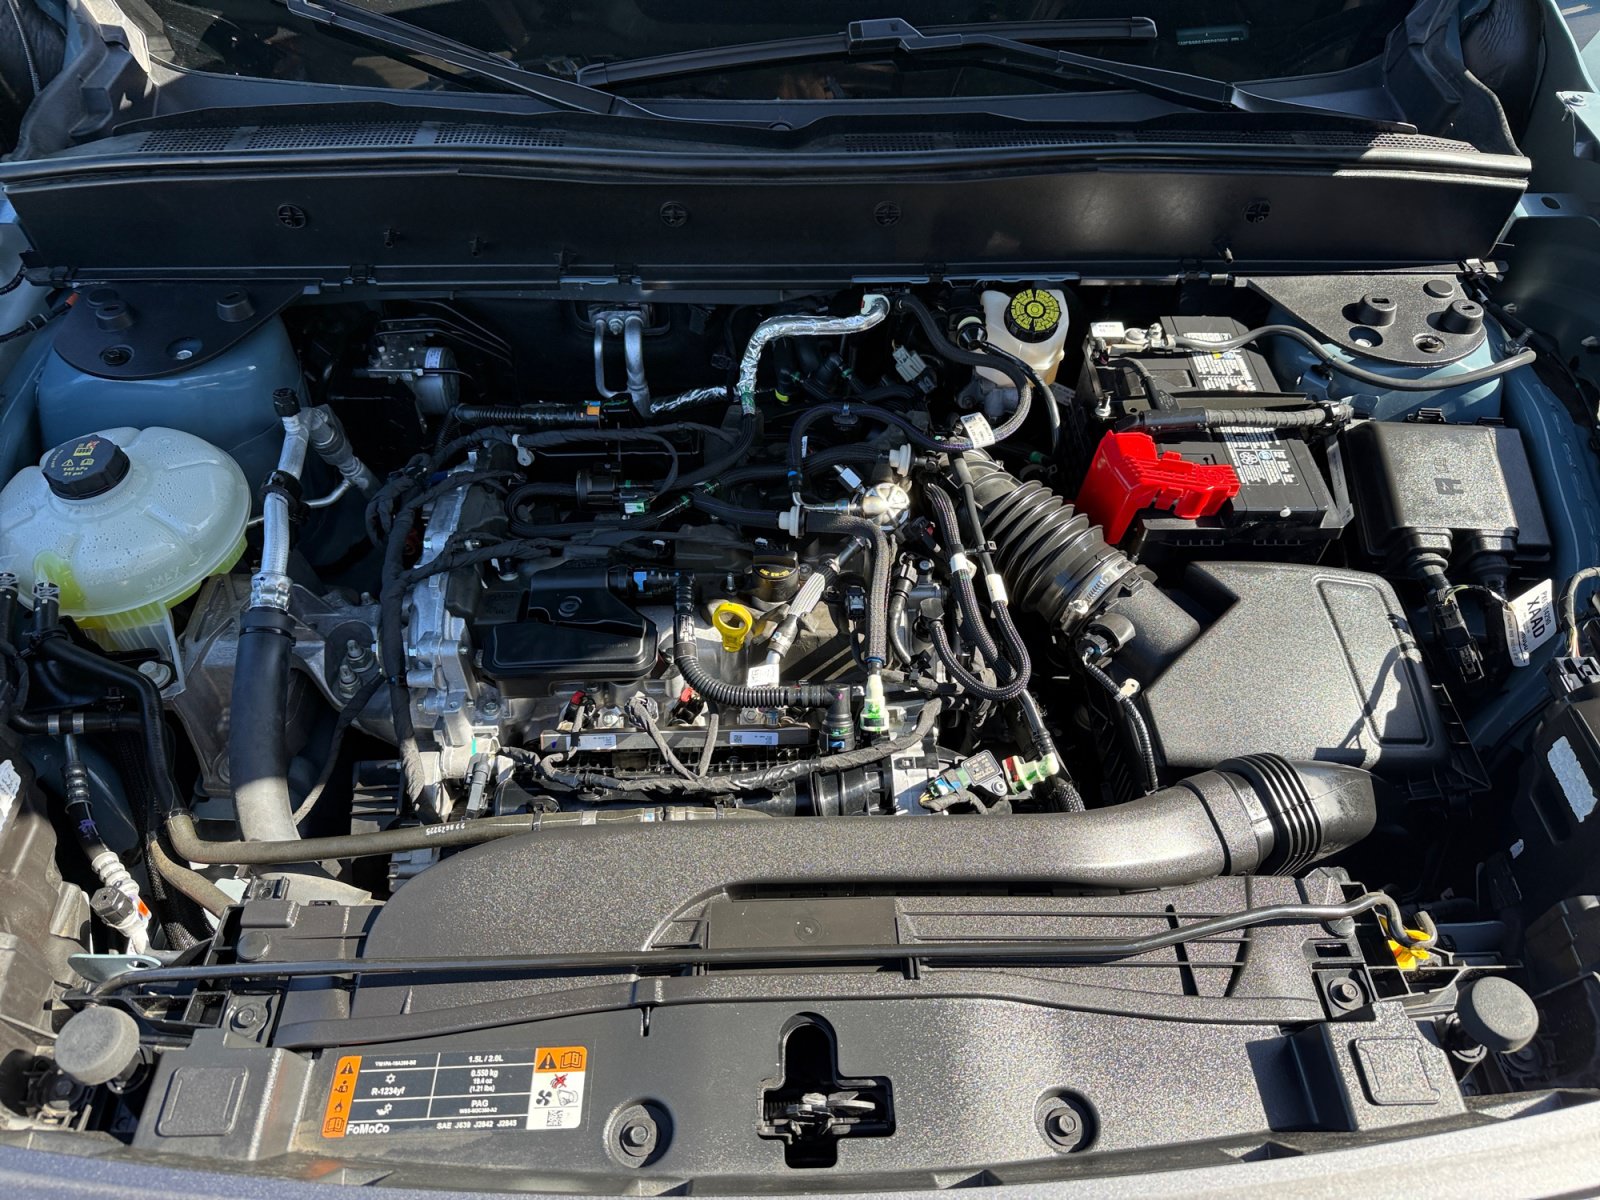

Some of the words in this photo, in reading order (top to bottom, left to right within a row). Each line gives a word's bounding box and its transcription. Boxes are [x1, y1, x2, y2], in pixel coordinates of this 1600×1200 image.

[1527, 595, 1546, 638] XAAD
[468, 1055, 483, 1063] 1.5L
[488, 1054, 504, 1062] 2.0L
[471, 1069, 488, 1077] 0.550
[489, 1068, 499, 1078] kg
[371, 1086, 406, 1096] R-1234yf
[471, 1099, 489, 1108] PAG
[346, 1123, 390, 1135] FoMoCo
[436, 1121, 452, 1130] SAE
[454, 1120, 471, 1129] J639
[473, 1120, 494, 1128] J2842
[496, 1119, 517, 1127] J2845
